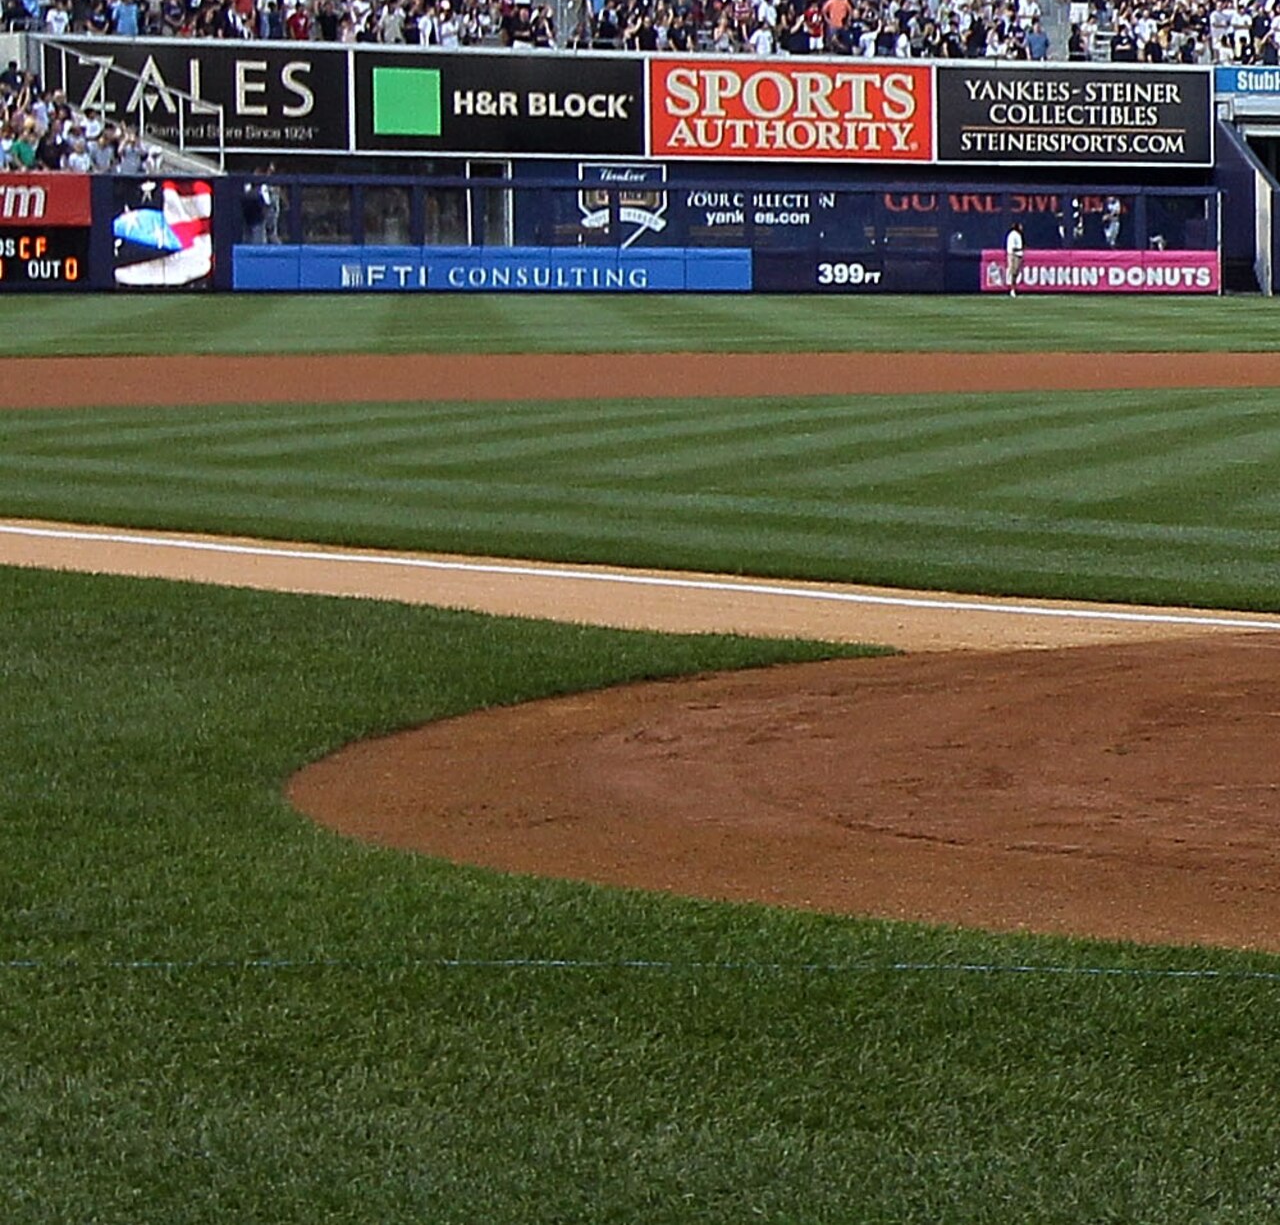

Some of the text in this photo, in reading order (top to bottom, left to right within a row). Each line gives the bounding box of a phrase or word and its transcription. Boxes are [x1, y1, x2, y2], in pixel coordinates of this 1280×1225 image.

[78, 54, 315, 117] ZALES
[665, 66, 917, 120] SPORTS
[454, 91, 628, 119] H&R BLOCK
[989, 103, 1158, 126] COLLECTIBLES
[667, 117, 913, 152] AUTHORITY
[961, 131, 1185, 155] STEINERSPORTS.COM
[28, 260, 61, 279] OUT
[367, 264, 649, 288] FTI CONSULTING
[1108, 267, 1211, 287] DONUTS
